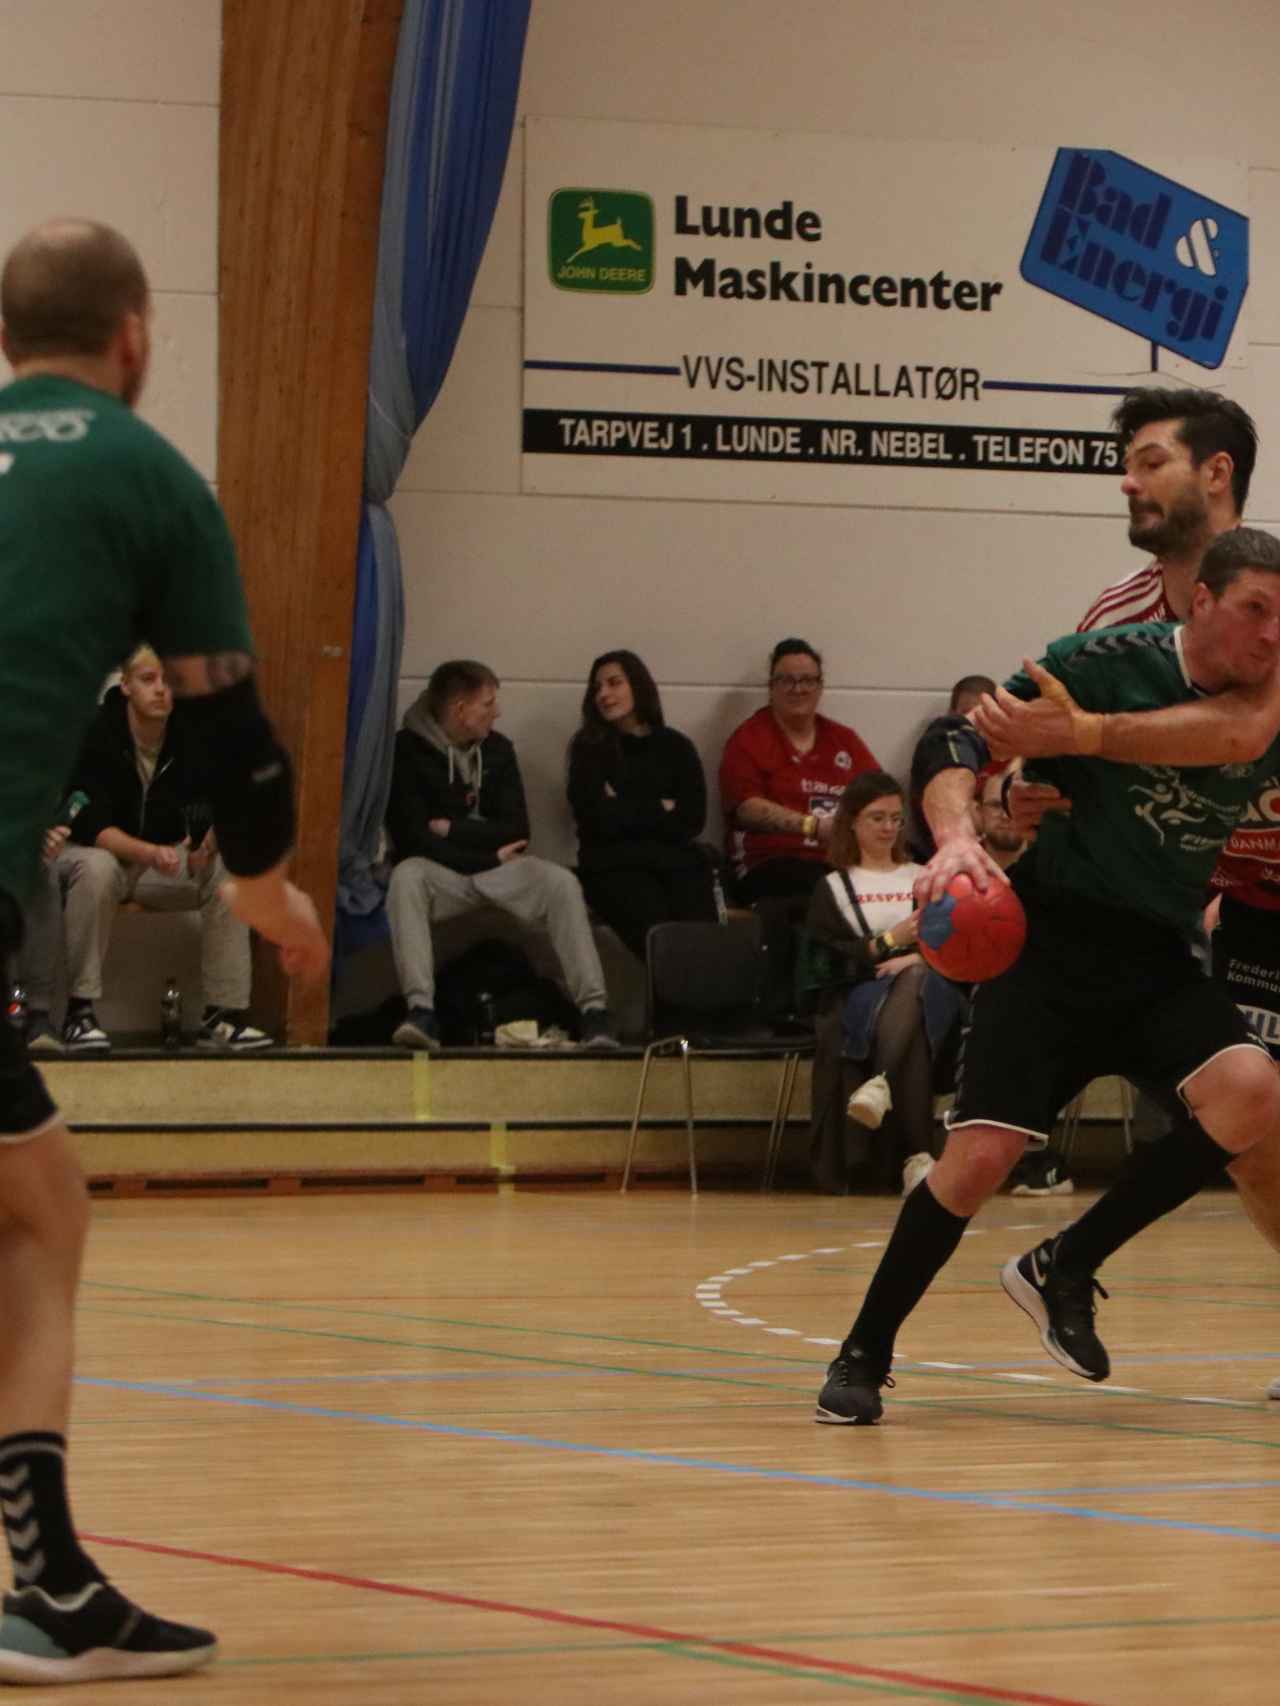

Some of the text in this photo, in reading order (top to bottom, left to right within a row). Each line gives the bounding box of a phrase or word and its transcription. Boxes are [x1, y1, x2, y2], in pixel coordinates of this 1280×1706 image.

[674, 194, 822, 242] Lunde
[1057, 151, 1219, 278] Bad &
[557, 266, 647, 282] JOHN DEERE
[674, 256, 1003, 312] Maskincenter
[1039, 204, 1229, 342] Energi
[682, 354, 981, 401] VVS-INSTALLATØR
[558, 418, 1119, 468] TARPVEJ 1 LUNDE NR. NEBEL TELEFON 75
